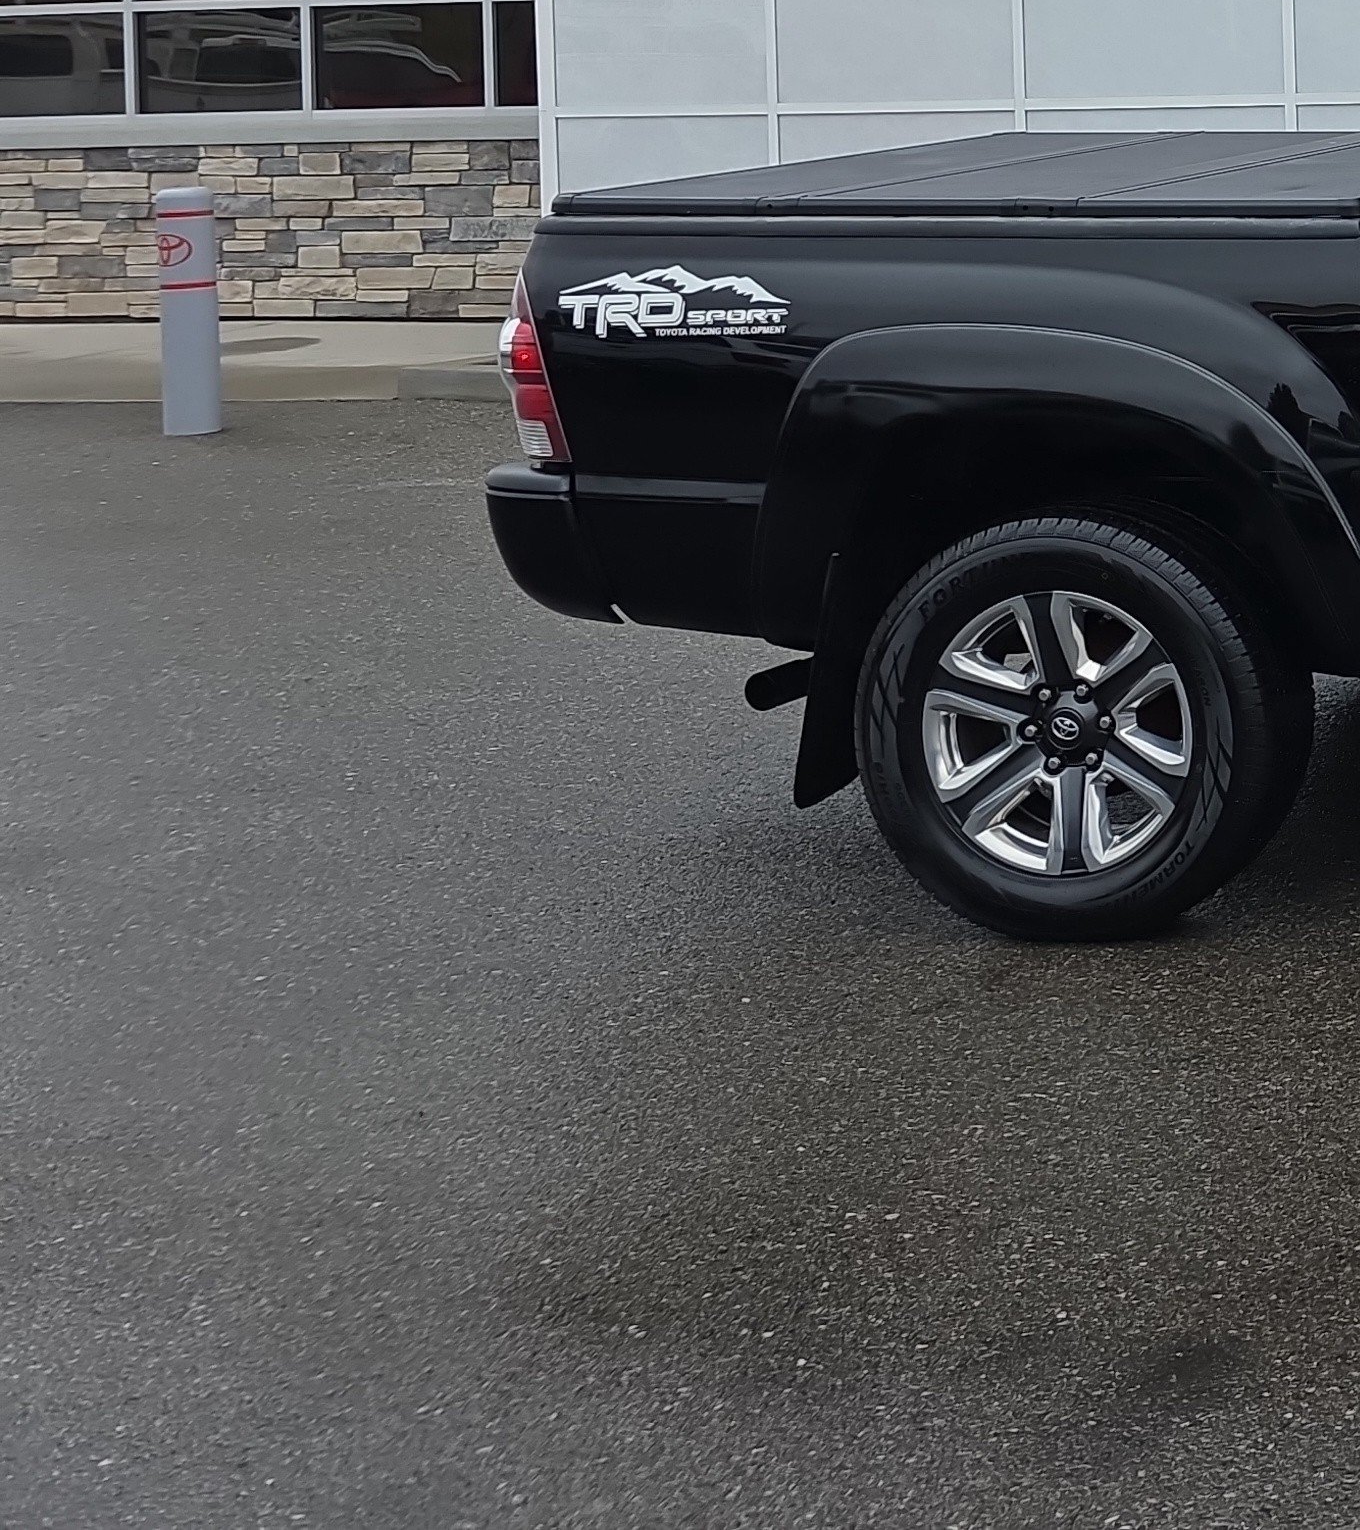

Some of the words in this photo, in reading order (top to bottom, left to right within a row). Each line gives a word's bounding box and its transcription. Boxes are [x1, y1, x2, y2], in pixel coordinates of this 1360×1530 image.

[558, 293, 686, 338] TRD
[686, 309, 788, 326] SPORT
[655, 327, 688, 337] TOYOTA
[689, 327, 721, 336] RACING
[723, 325, 787, 336] DEVELOPMENT
